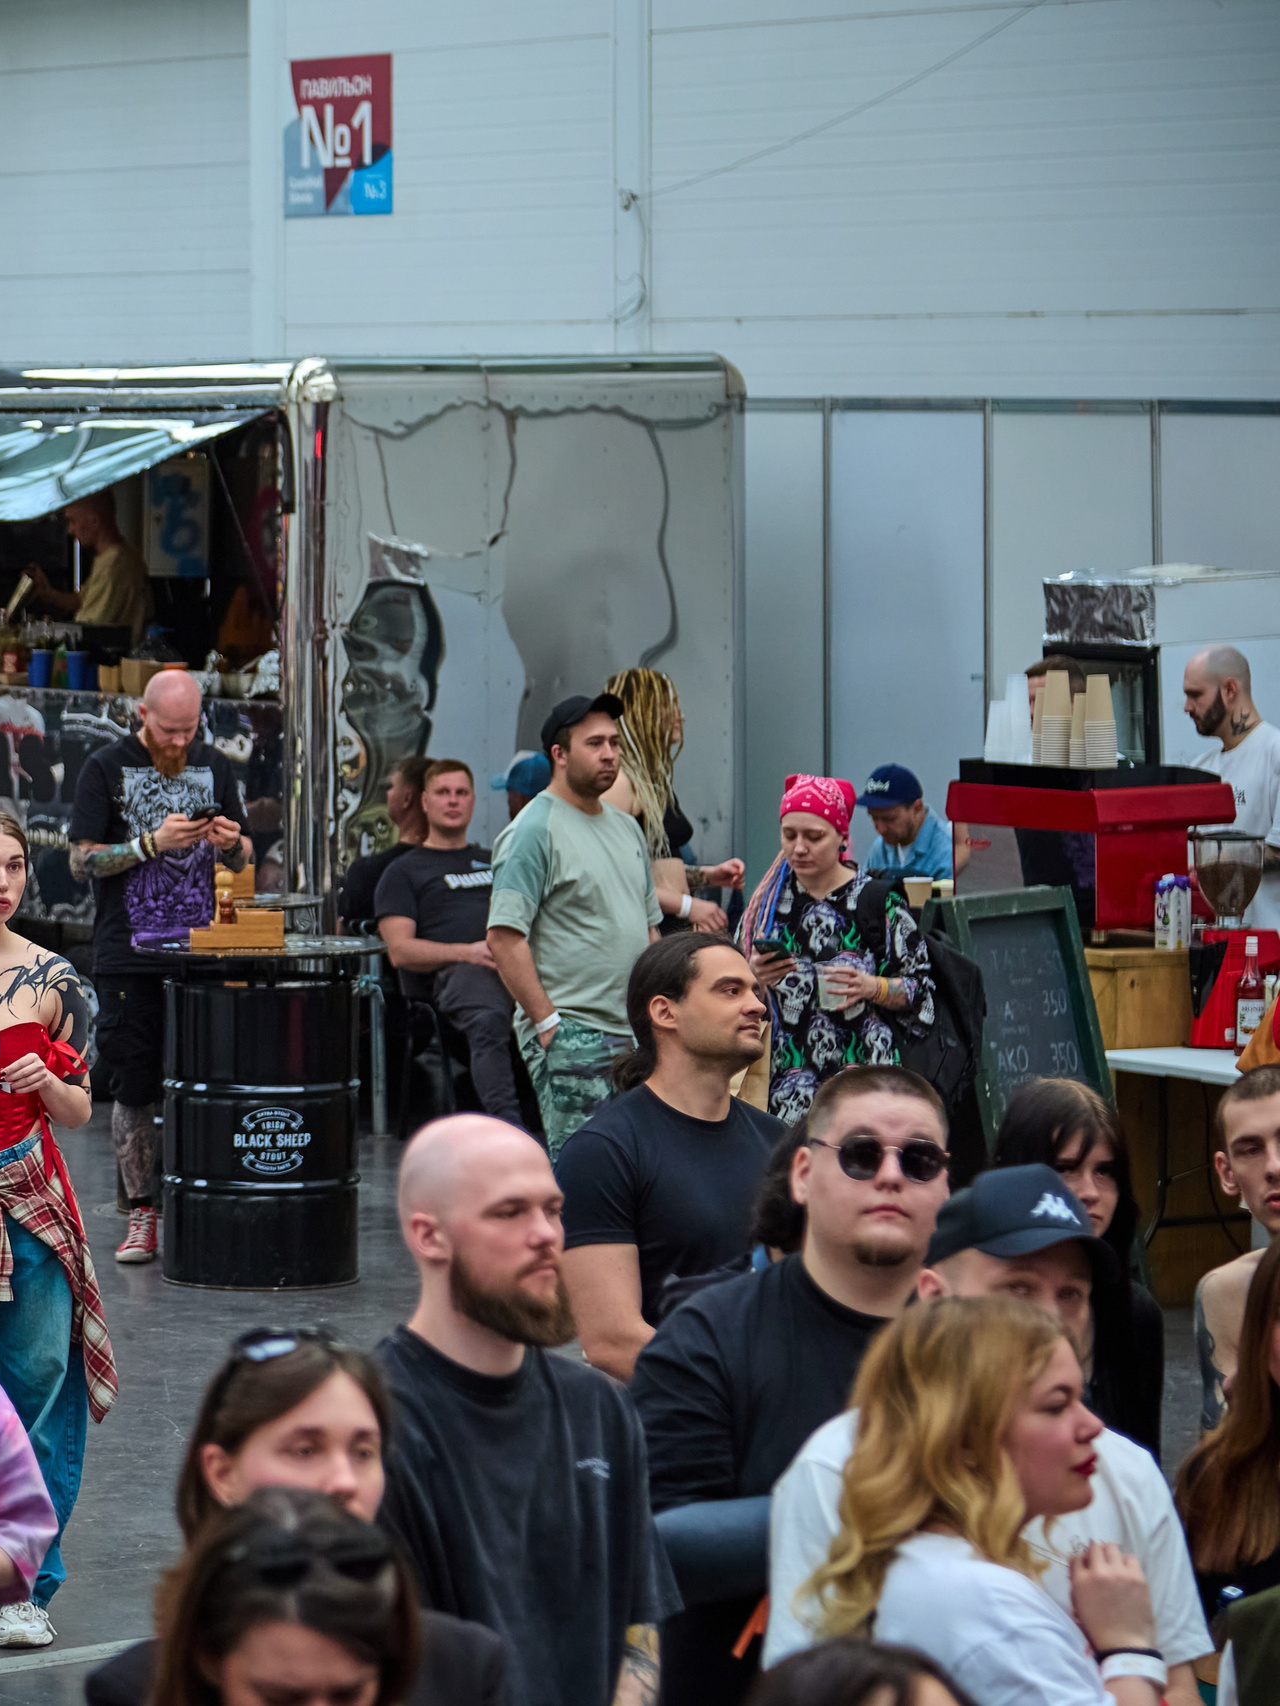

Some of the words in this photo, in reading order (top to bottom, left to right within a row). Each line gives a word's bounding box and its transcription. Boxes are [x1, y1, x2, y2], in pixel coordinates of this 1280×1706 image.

[299, 74, 372, 99] ПАВИЛЬОН
[300, 100, 373, 170] №1
[444, 870, 493, 890] PUM
[1041, 988, 1068, 1017] 350
[1049, 1040, 1079, 1075] 350
[261, 1120, 286, 1130] IRISH
[233, 1133, 273, 1148] BLACK
[275, 1132, 312, 1148] SHEEP
[260, 1151, 287, 1162] STOUT
